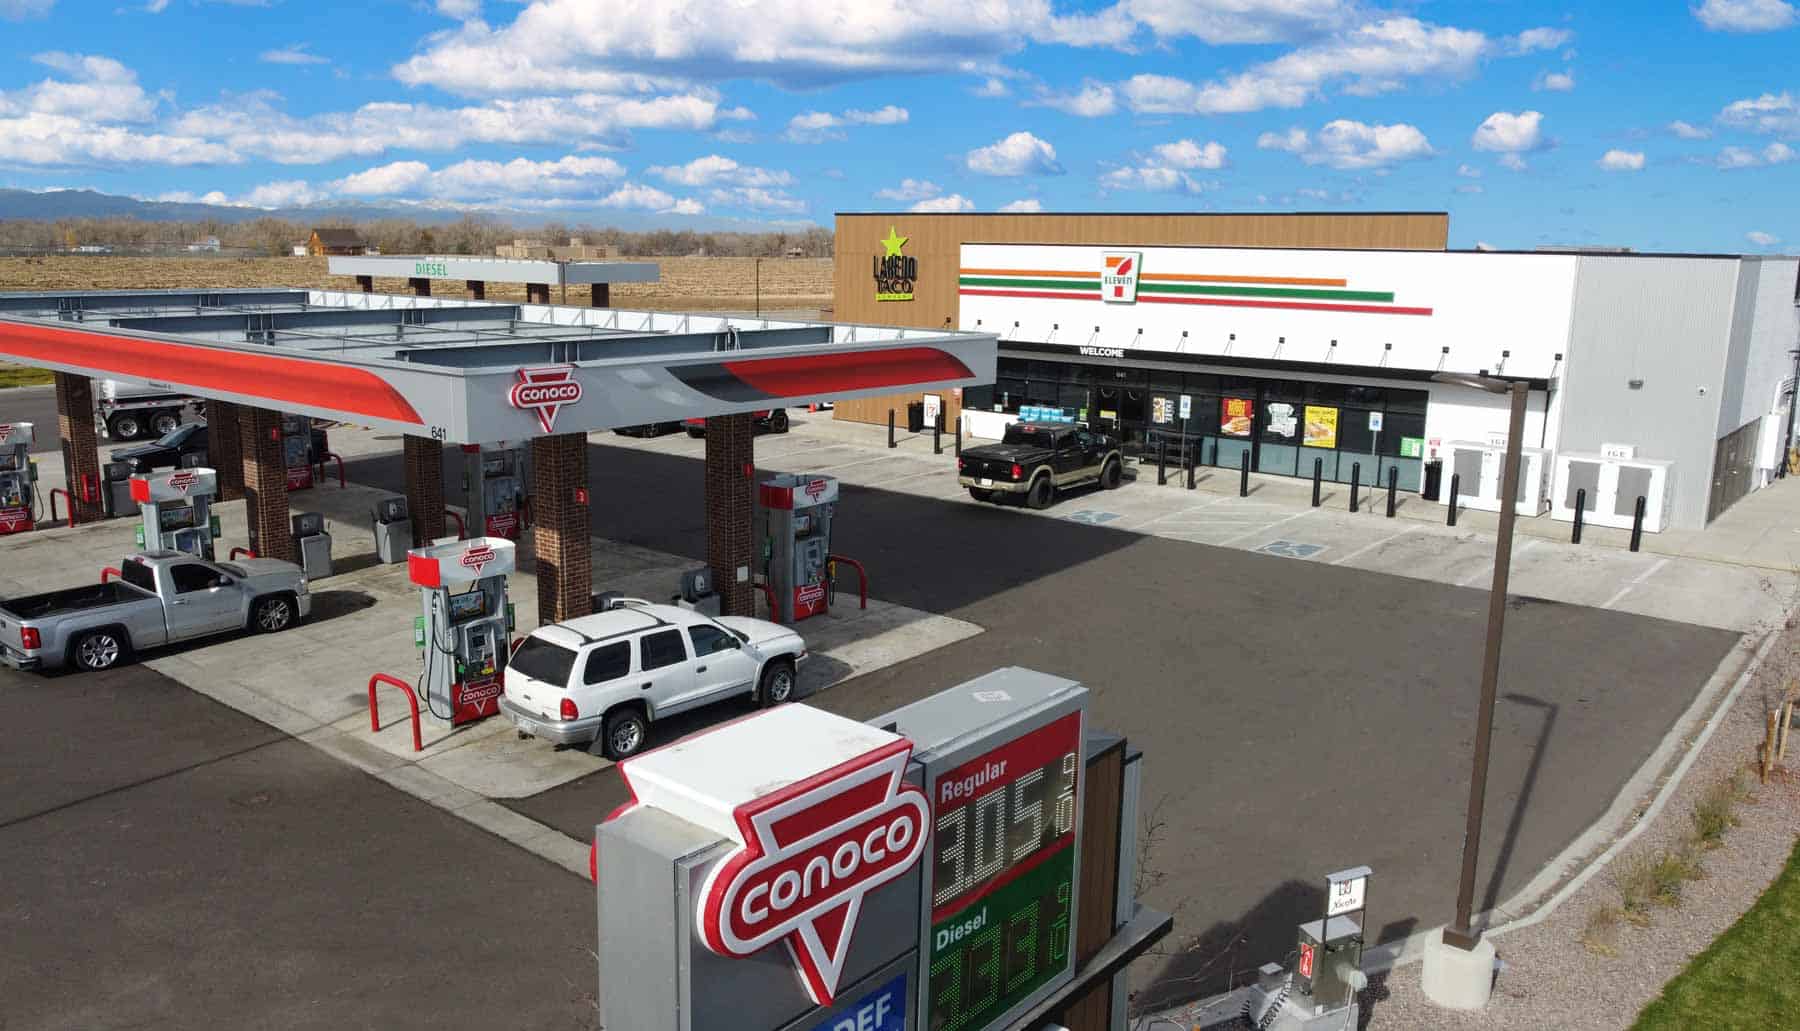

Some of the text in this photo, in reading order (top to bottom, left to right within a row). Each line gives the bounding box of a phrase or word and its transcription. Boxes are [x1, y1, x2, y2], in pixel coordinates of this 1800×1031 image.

[415, 262, 448, 276] DIESEL
[877, 277, 913, 294] TACO
[1080, 346, 1125, 358] WELCOME
[431, 426, 447, 440] 641
[940, 759, 1008, 804] Regular
[936, 906, 987, 953] Diesel
